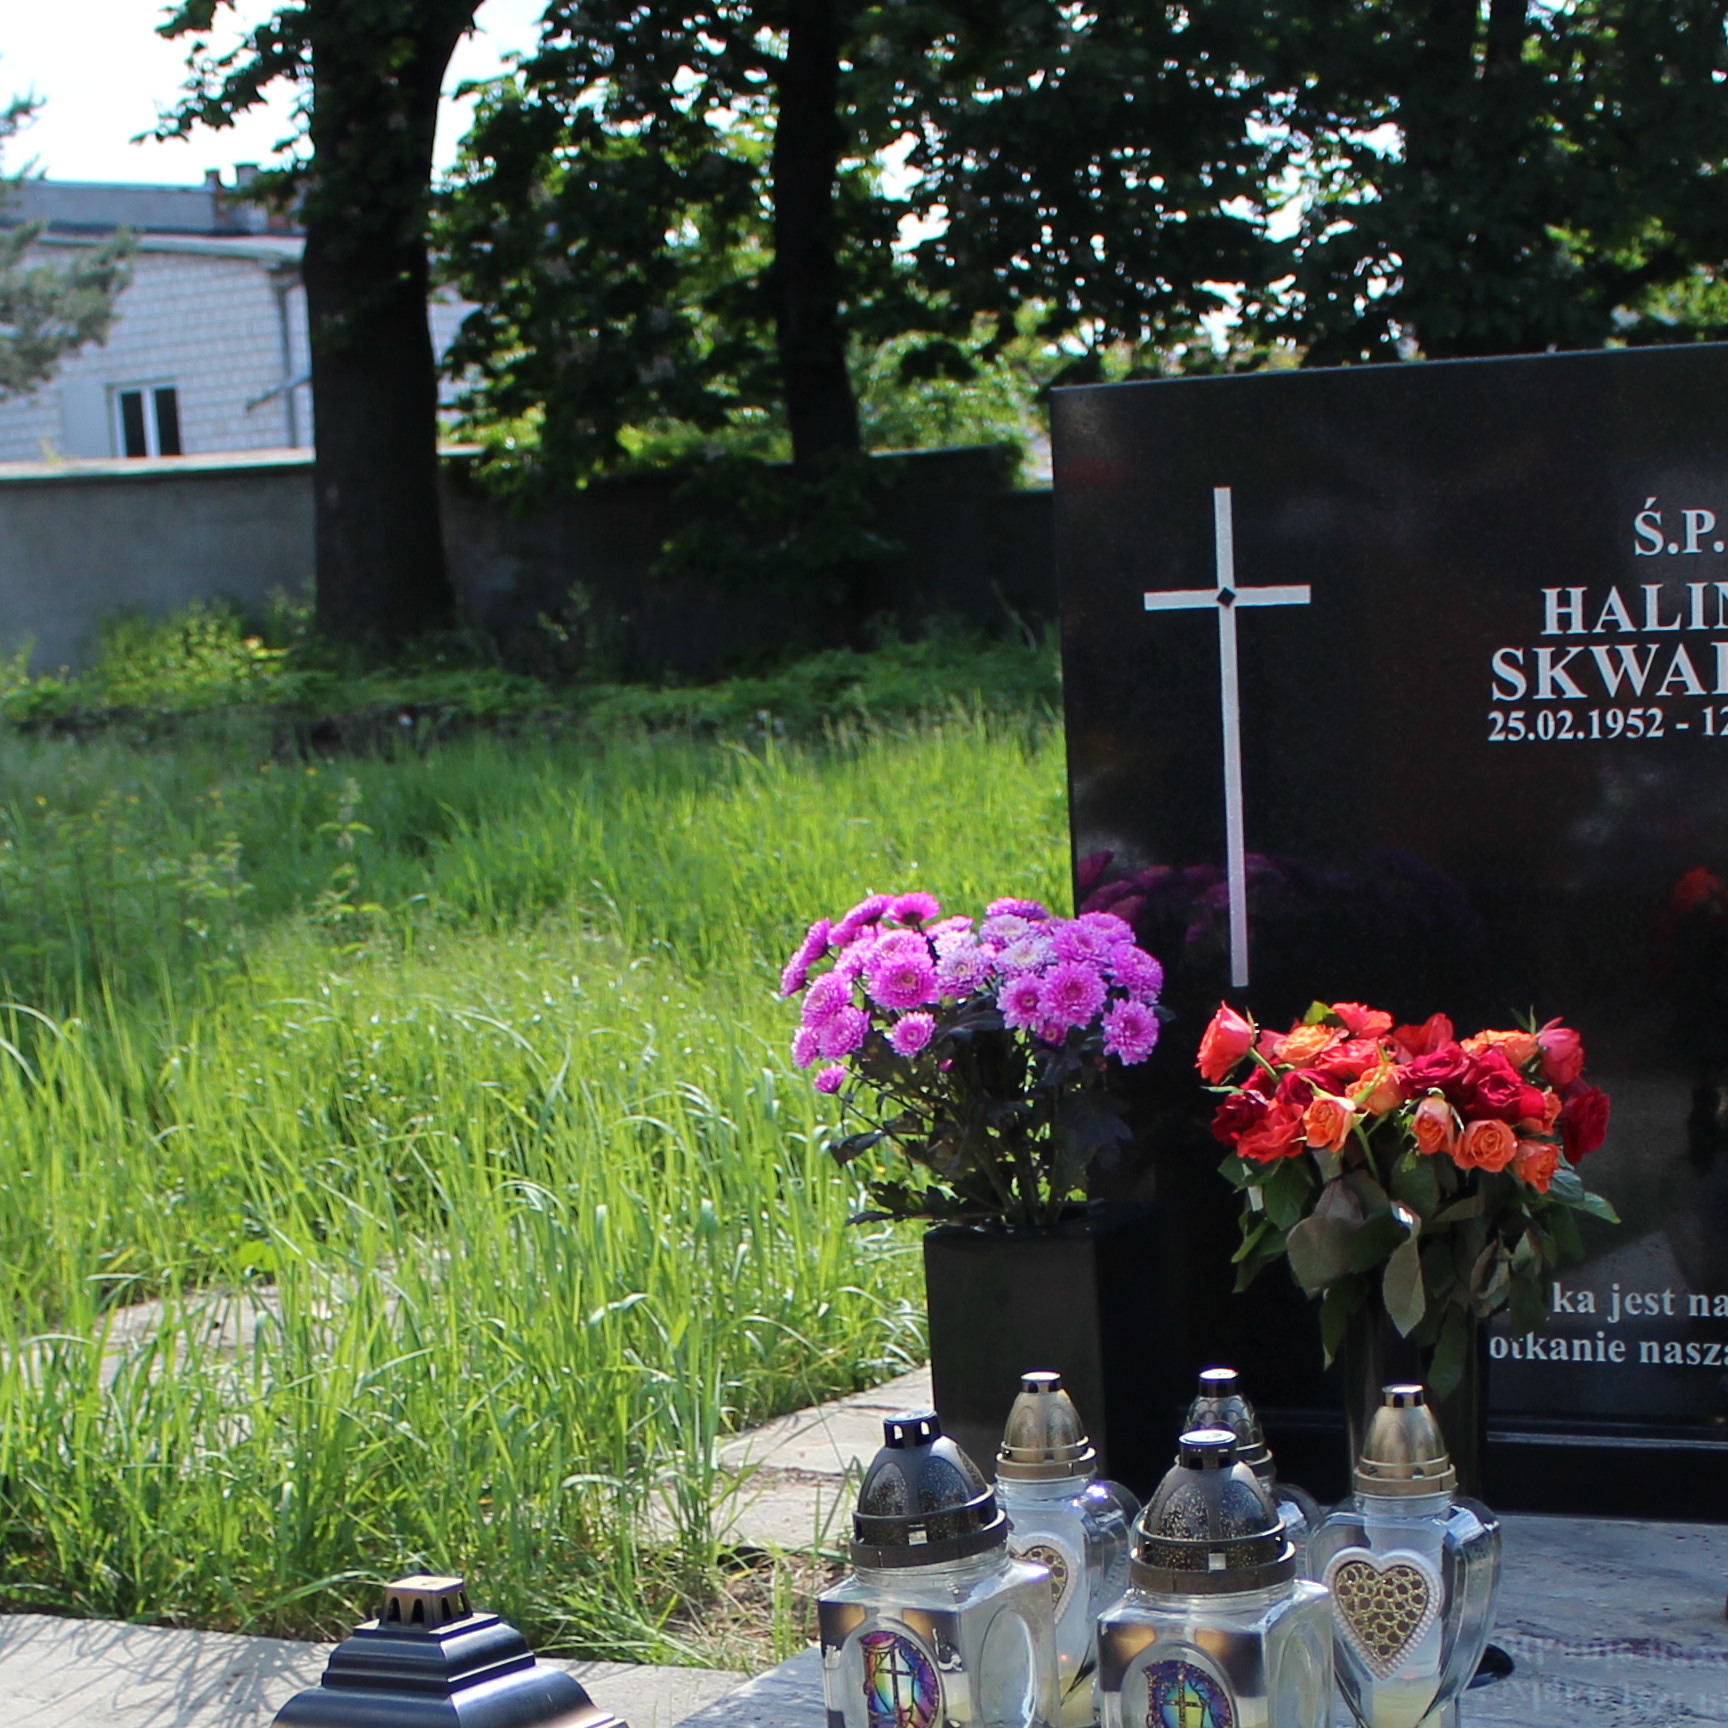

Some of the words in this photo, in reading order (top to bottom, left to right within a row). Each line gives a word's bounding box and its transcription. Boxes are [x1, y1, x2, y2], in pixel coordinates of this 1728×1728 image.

[1633, 496, 1726, 556] Ś.P.
[1487, 706, 1665, 742] 25.02.1952
[1607, 1282, 1676, 1323] jest
[1489, 1330, 1626, 1363] otkanie
